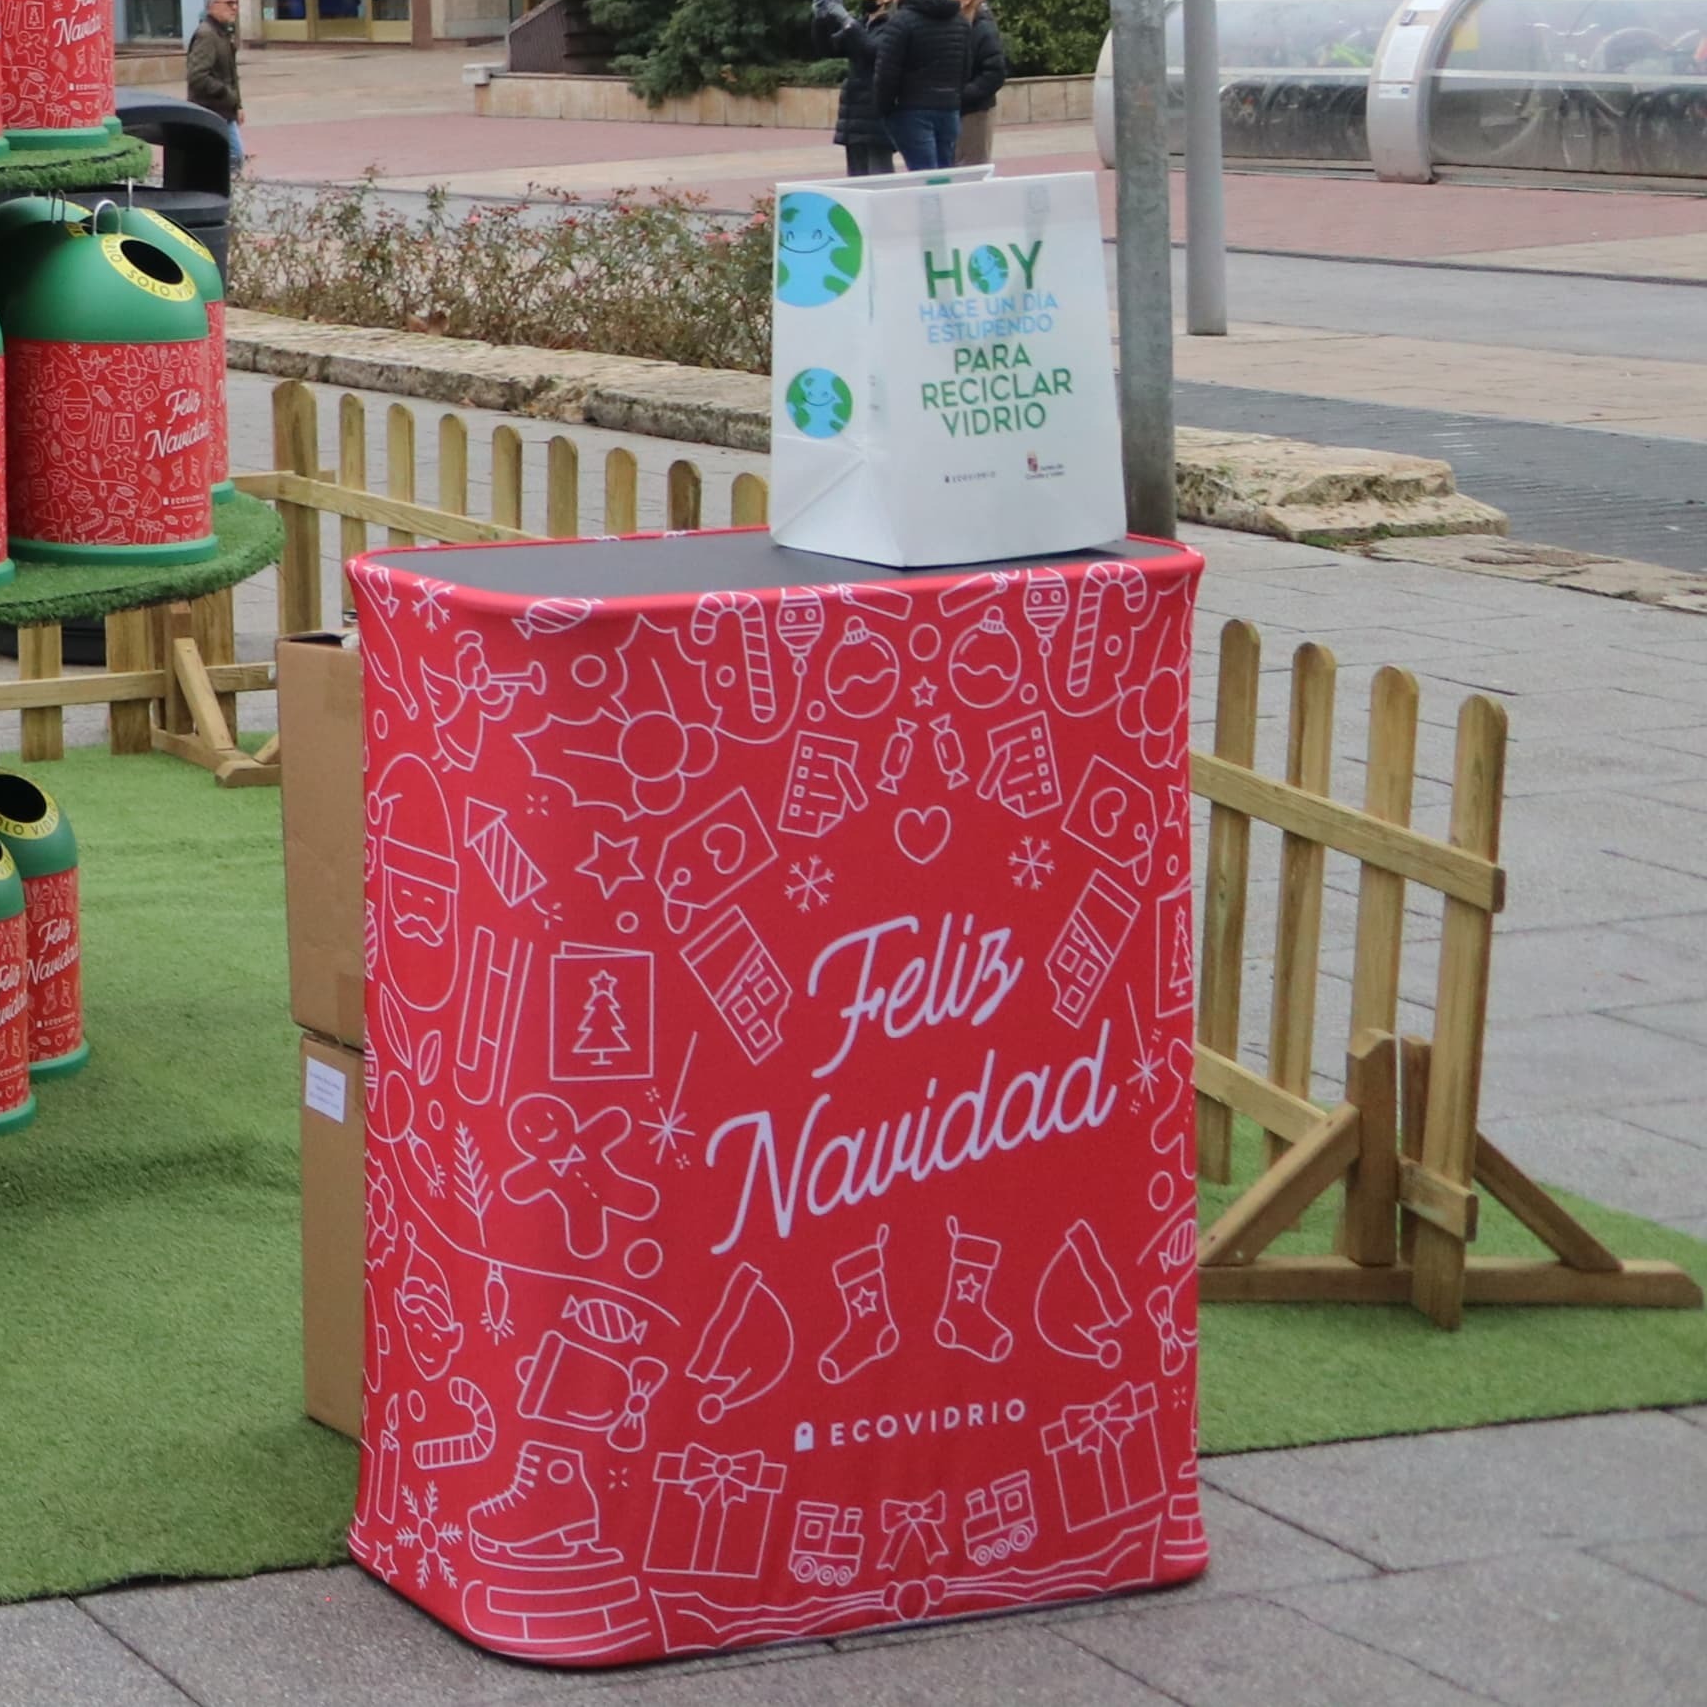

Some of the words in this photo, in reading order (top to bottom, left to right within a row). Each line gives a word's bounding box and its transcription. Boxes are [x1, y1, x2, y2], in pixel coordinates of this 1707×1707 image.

[126, 268, 171, 298] SOLO
[924, 240, 1043, 298] HOY
[919, 300, 977, 321] HACE
[987, 297, 1014, 316] UN
[928, 313, 1053, 344] ESTUPENDO
[954, 344, 1031, 374] PARA
[165, 388, 201, 425] Feliz
[922, 368, 1073, 411] RECICLAR
[941, 402, 1046, 438] VIDRIO
[38, 917, 71, 951] Feliz
[806, 913, 1023, 1081] Feliz
[707, 1019, 1117, 1257] Navidad
[829, 1398, 1028, 1448] ECOVIDRIO
